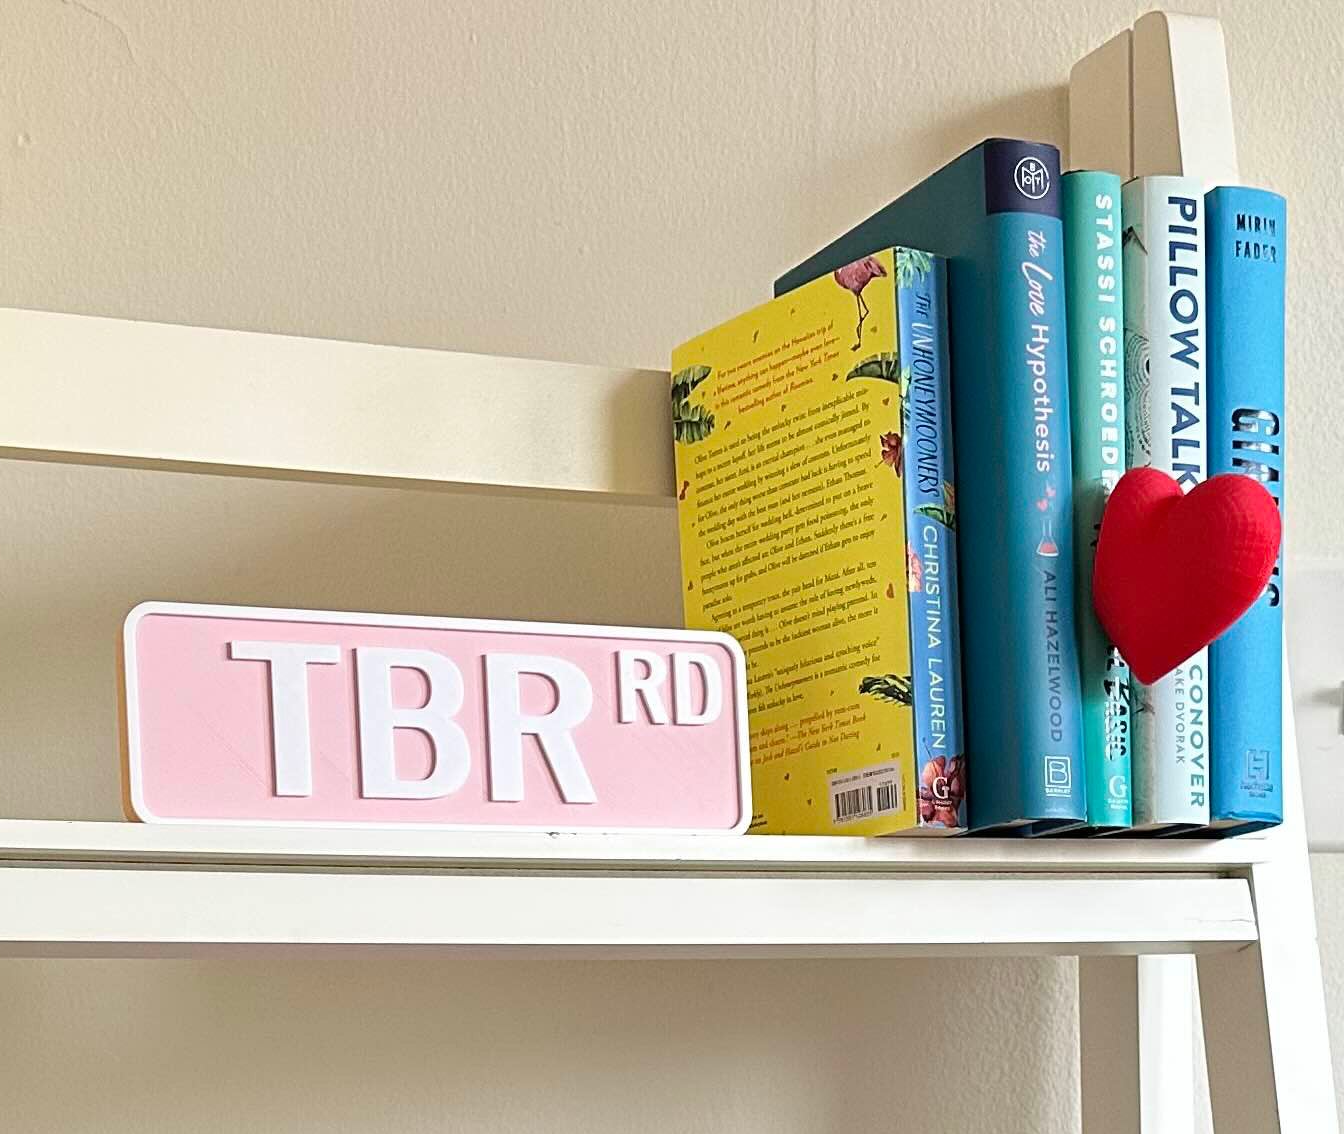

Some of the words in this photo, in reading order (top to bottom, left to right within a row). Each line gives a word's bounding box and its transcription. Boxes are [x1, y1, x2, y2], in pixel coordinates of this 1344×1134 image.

[1027, 230, 1047, 257] the
[1096, 194, 1116, 302] STASSI
[1235, 240, 1277, 263] FADER
[1236, 214, 1276, 237] MIRIN
[1022, 262, 1053, 317] Love
[1167, 196, 1199, 369] PILLOW
[911, 322, 940, 497] UNHONEYMOONERS
[1025, 324, 1055, 473] Hypothesis
[1098, 316, 1119, 490] SCHROEDE
[1169, 382, 1200, 488] TALK
[922, 526, 942, 649] CHRISTINA
[1044, 570, 1056, 601] ALI
[226, 641, 597, 804] TBR
[614, 649, 722, 726] RD
[927, 659, 946, 749] LAUREN
[1045, 611, 1063, 742] HAZELWOOD
[1175, 702, 1186, 765] DVORAK
[1189, 665, 1205, 807] CONOVER
